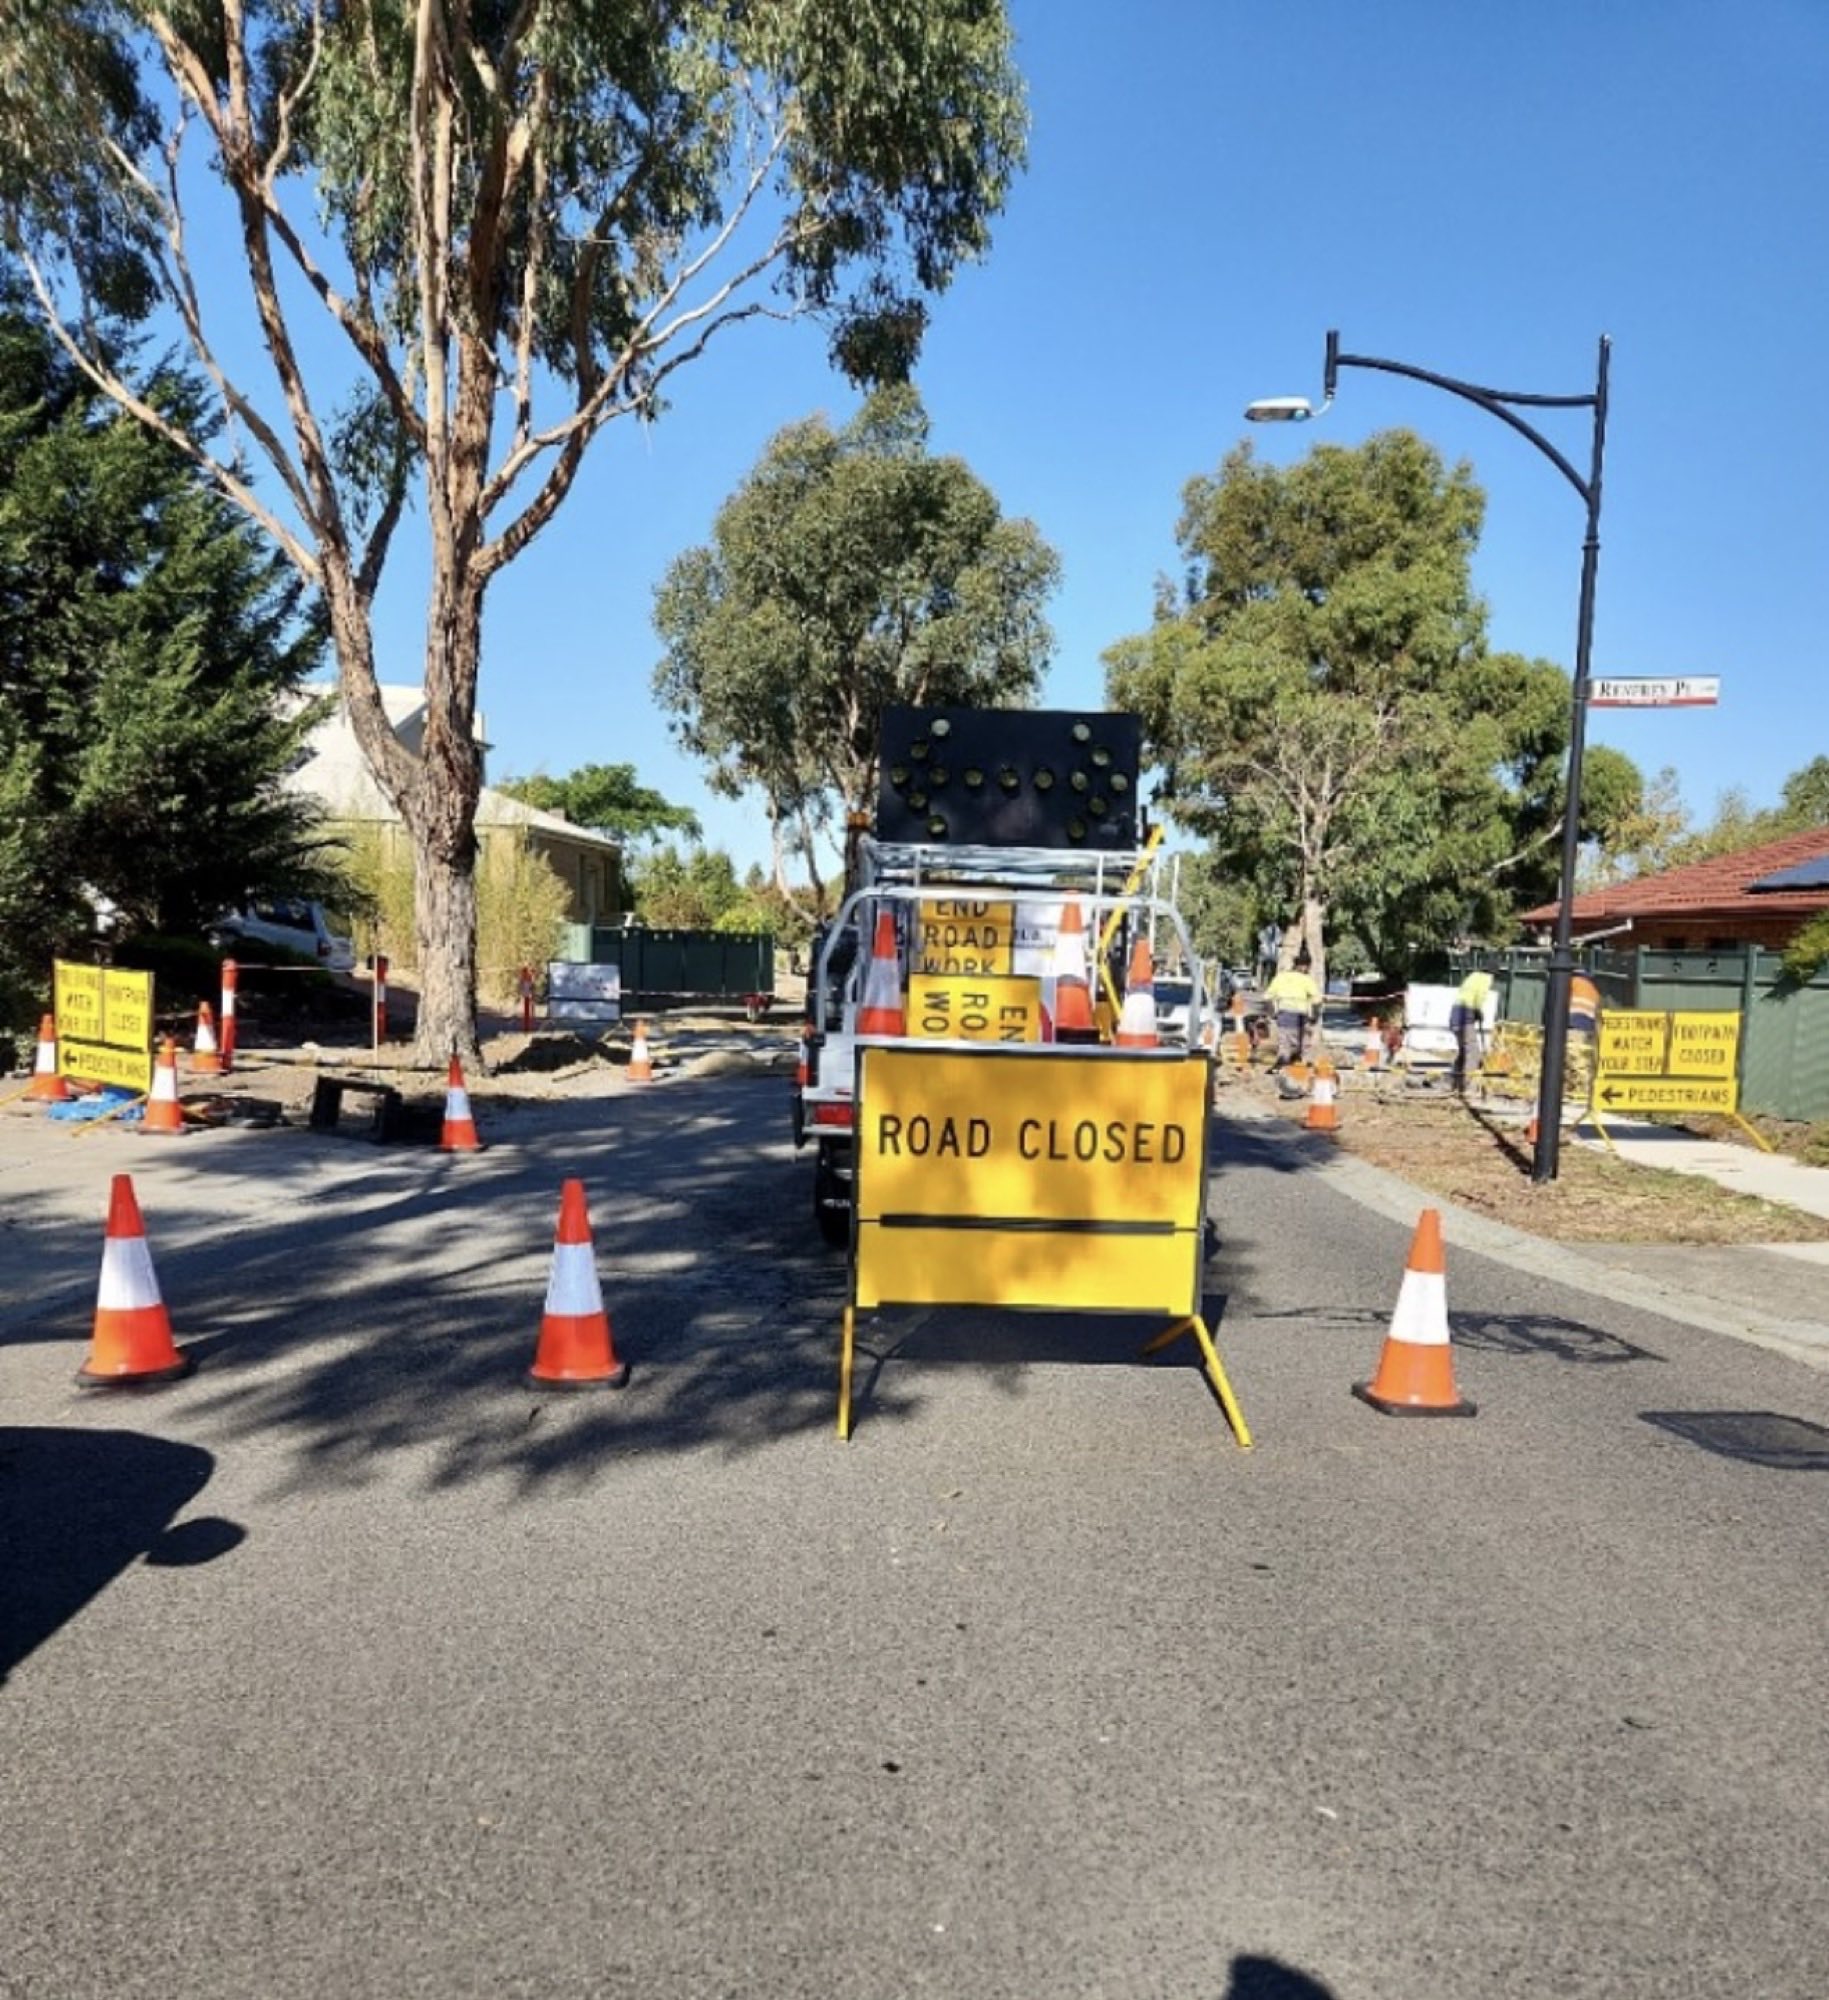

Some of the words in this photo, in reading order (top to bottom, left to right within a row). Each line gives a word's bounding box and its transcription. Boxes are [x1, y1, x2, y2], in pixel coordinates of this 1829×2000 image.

[936, 901, 989, 918] END
[924, 924, 999, 949] ROAD
[924, 956, 996, 974] WORK
[922, 991, 949, 1032] WO
[960, 992, 988, 1039] RO
[999, 1006, 1027, 1042] EN
[1628, 1087, 1730, 1104] PEDESTRIANS
[879, 1114, 991, 1158] ROAD
[1019, 1119, 1186, 1163] CLOSED
